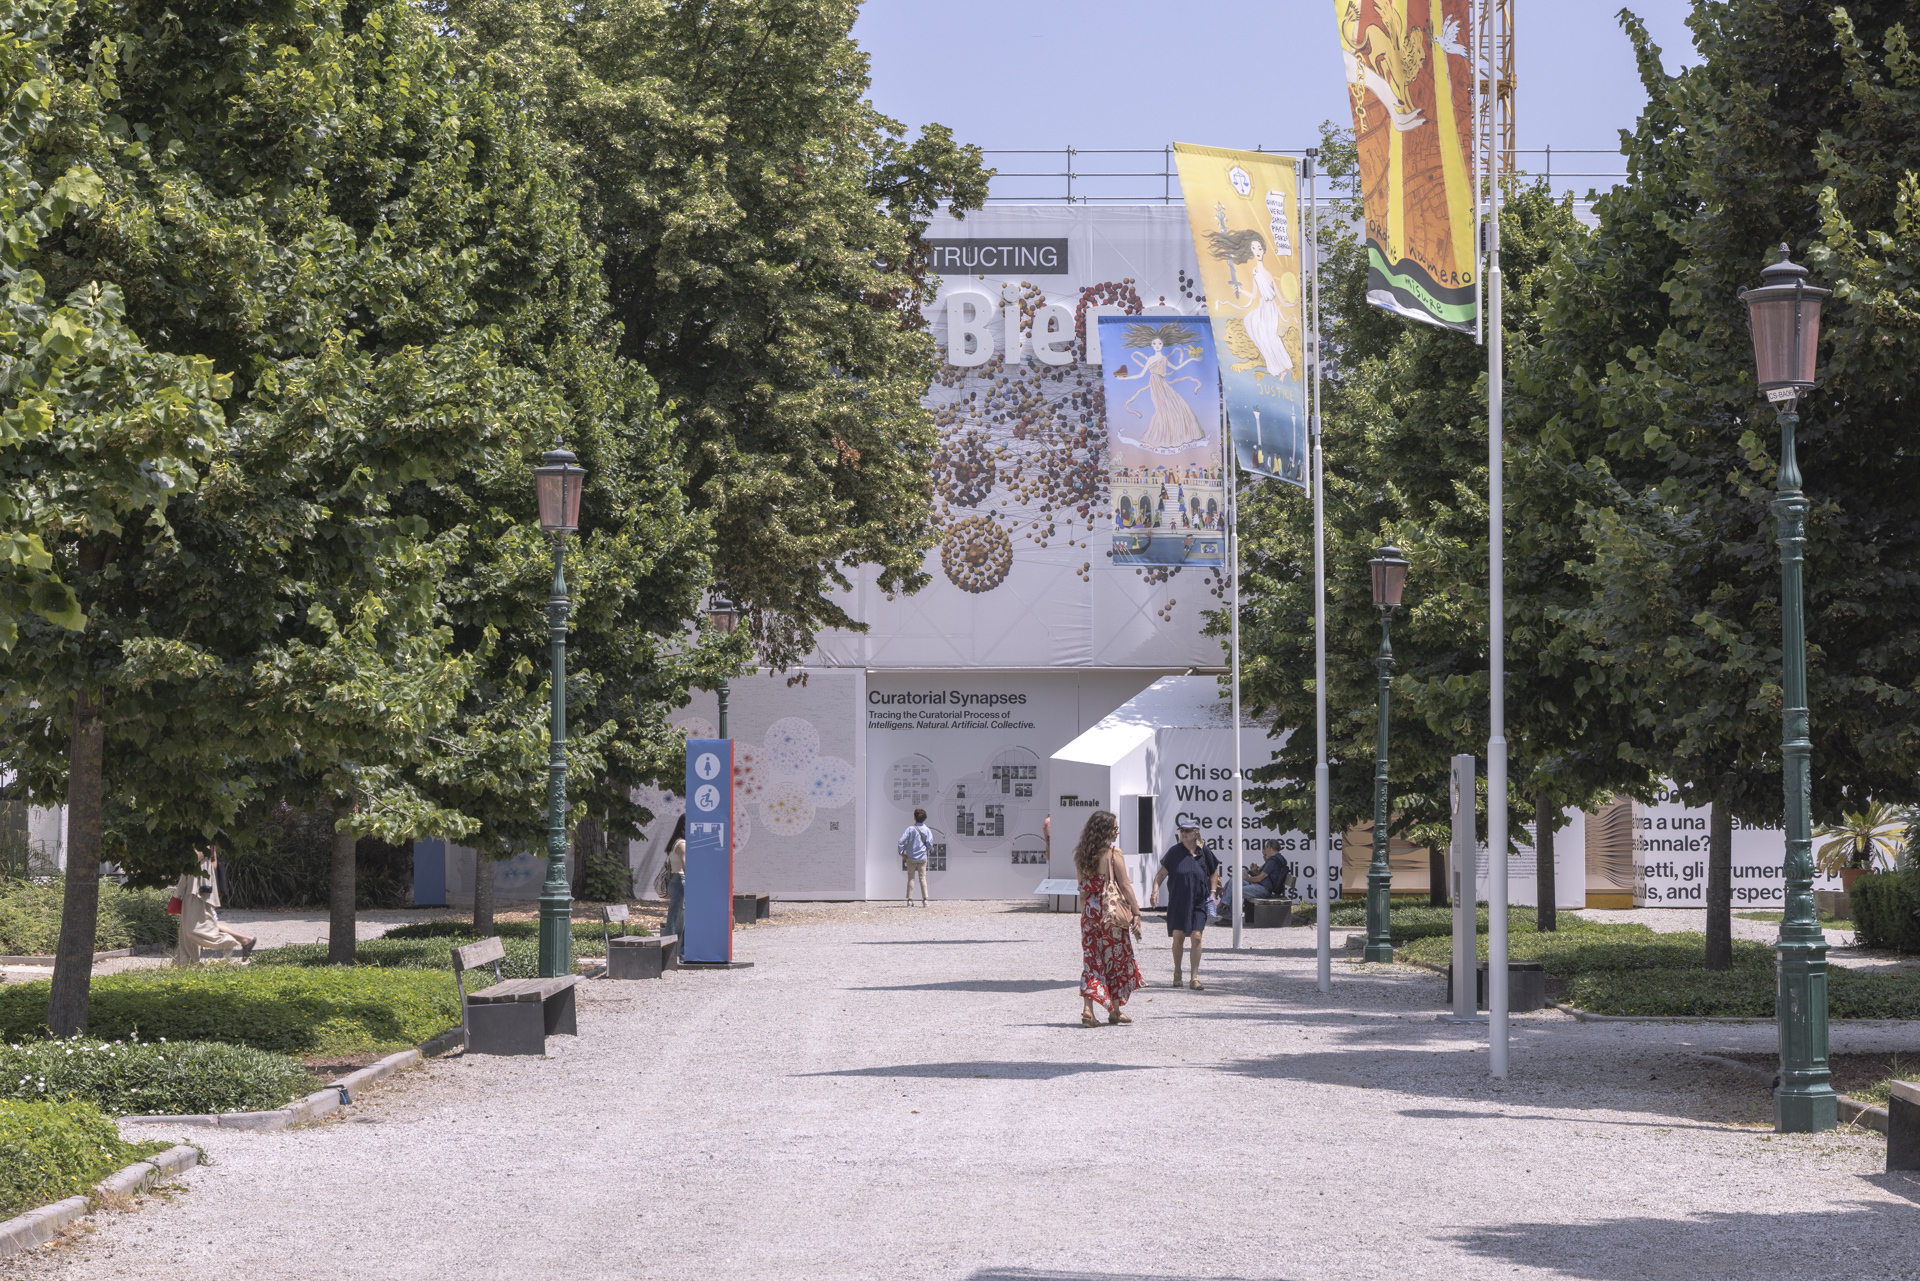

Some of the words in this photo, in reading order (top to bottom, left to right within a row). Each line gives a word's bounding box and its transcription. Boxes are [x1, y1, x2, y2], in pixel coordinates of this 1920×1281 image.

[1271, 225, 1286, 233] PACE
[925, 246, 1058, 267] TRUCTING
[1256, 384, 1294, 402] JUSTICE
[1139, 443, 1159, 452] MOTHER
[1178, 443, 1198, 451] REPUBLIC
[869, 690, 946, 705] Curatorial
[949, 690, 1027, 707] Synapses
[868, 710, 901, 720] Tracing
[902, 710, 917, 719] the
[919, 710, 962, 719] Curatorial
[963, 710, 1000, 719] Process
[1001, 710, 1011, 719] of
[868, 720, 915, 730] Intelligens.
[916, 720, 949, 729] Natural.
[951, 720, 989, 729] Artificial.
[990, 720, 1036, 729] Collective.
[1175, 763, 1206, 780] Chi
[1209, 767, 1255, 780] soo
[1175, 785, 1219, 802] Who
[1068, 798, 1100, 807] Biennale
[1656, 817, 1668, 830] a
[1671, 817, 1706, 830] una
[1300, 838, 1310, 851] a
[1682, 861, 1704, 881] gli
[1666, 883, 1701, 899] and
